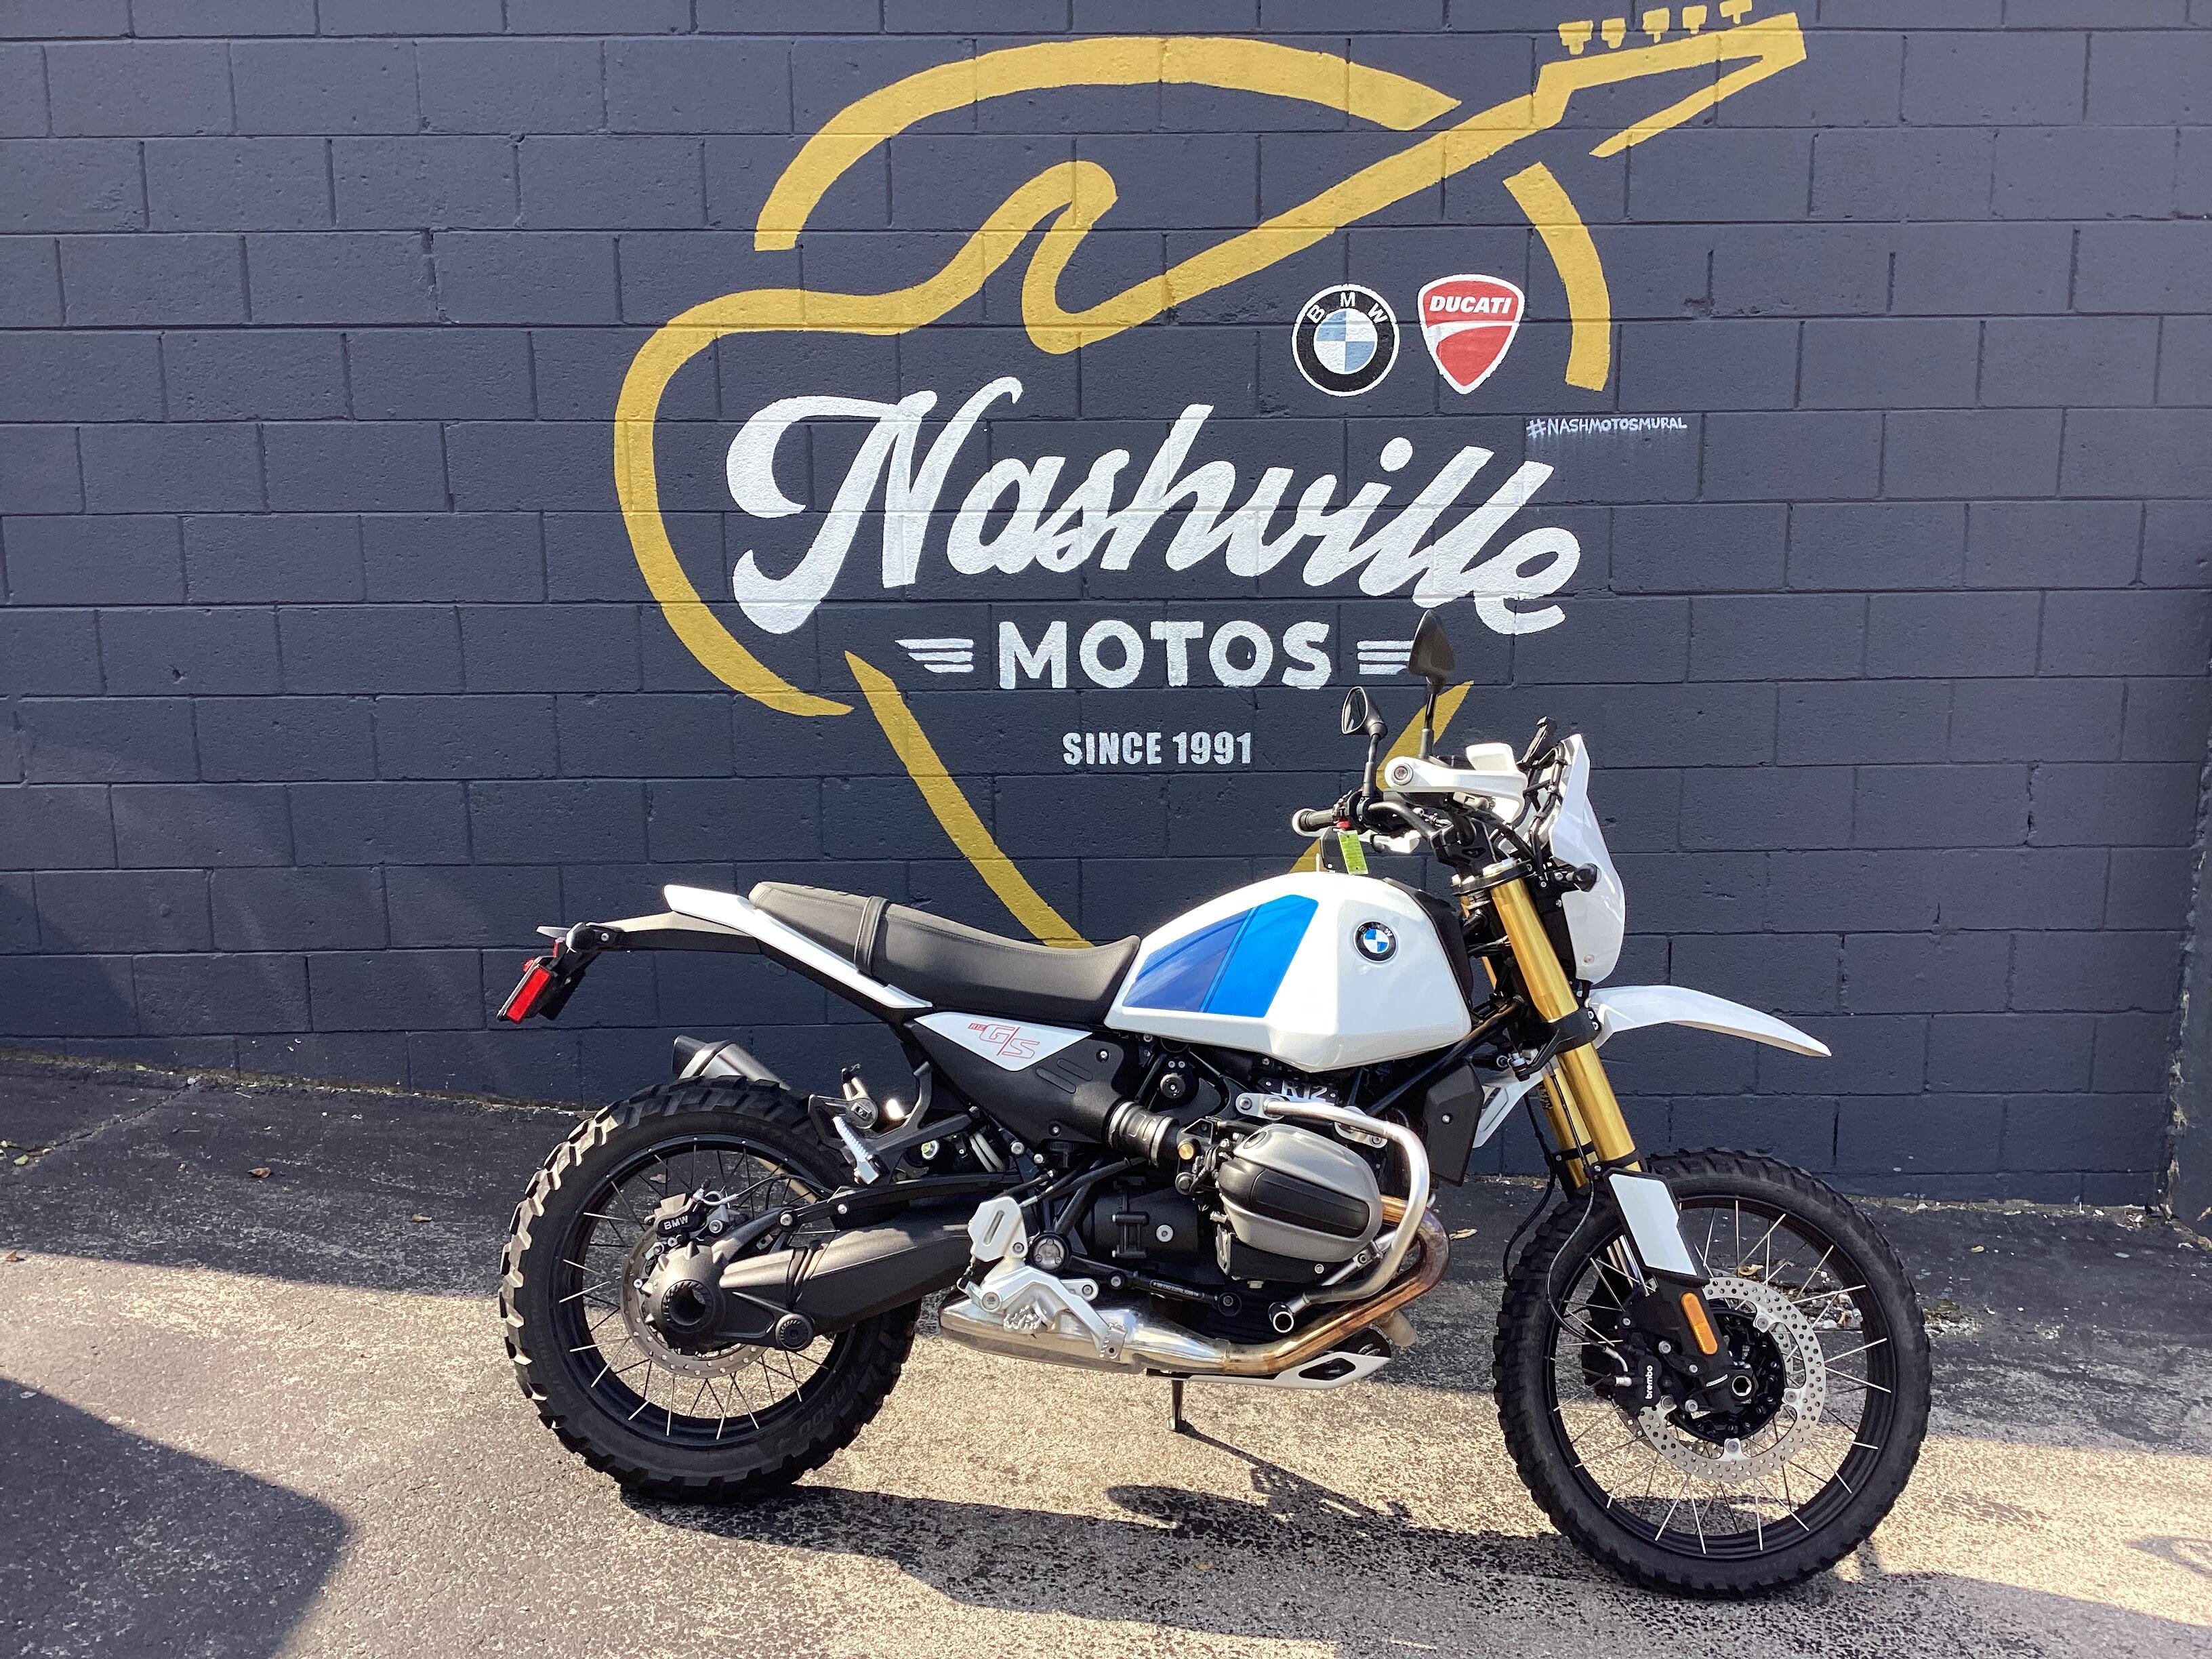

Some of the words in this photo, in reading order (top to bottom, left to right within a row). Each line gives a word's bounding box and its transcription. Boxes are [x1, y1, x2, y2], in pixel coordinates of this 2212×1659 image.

[1305, 291, 1388, 324] BMW
[1429, 295, 1513, 314] DUCATI
[1525, 416, 1688, 438] #NASHMOTOSMURAL
[726, 375, 1580, 636] Nashville
[998, 619, 1332, 690] MOTOS
[1062, 731, 1162, 765] SINCE
[1172, 731, 1252, 765] 1991
[663, 1215, 689, 1230] BMW
[1645, 1365, 1653, 1399] brembo
